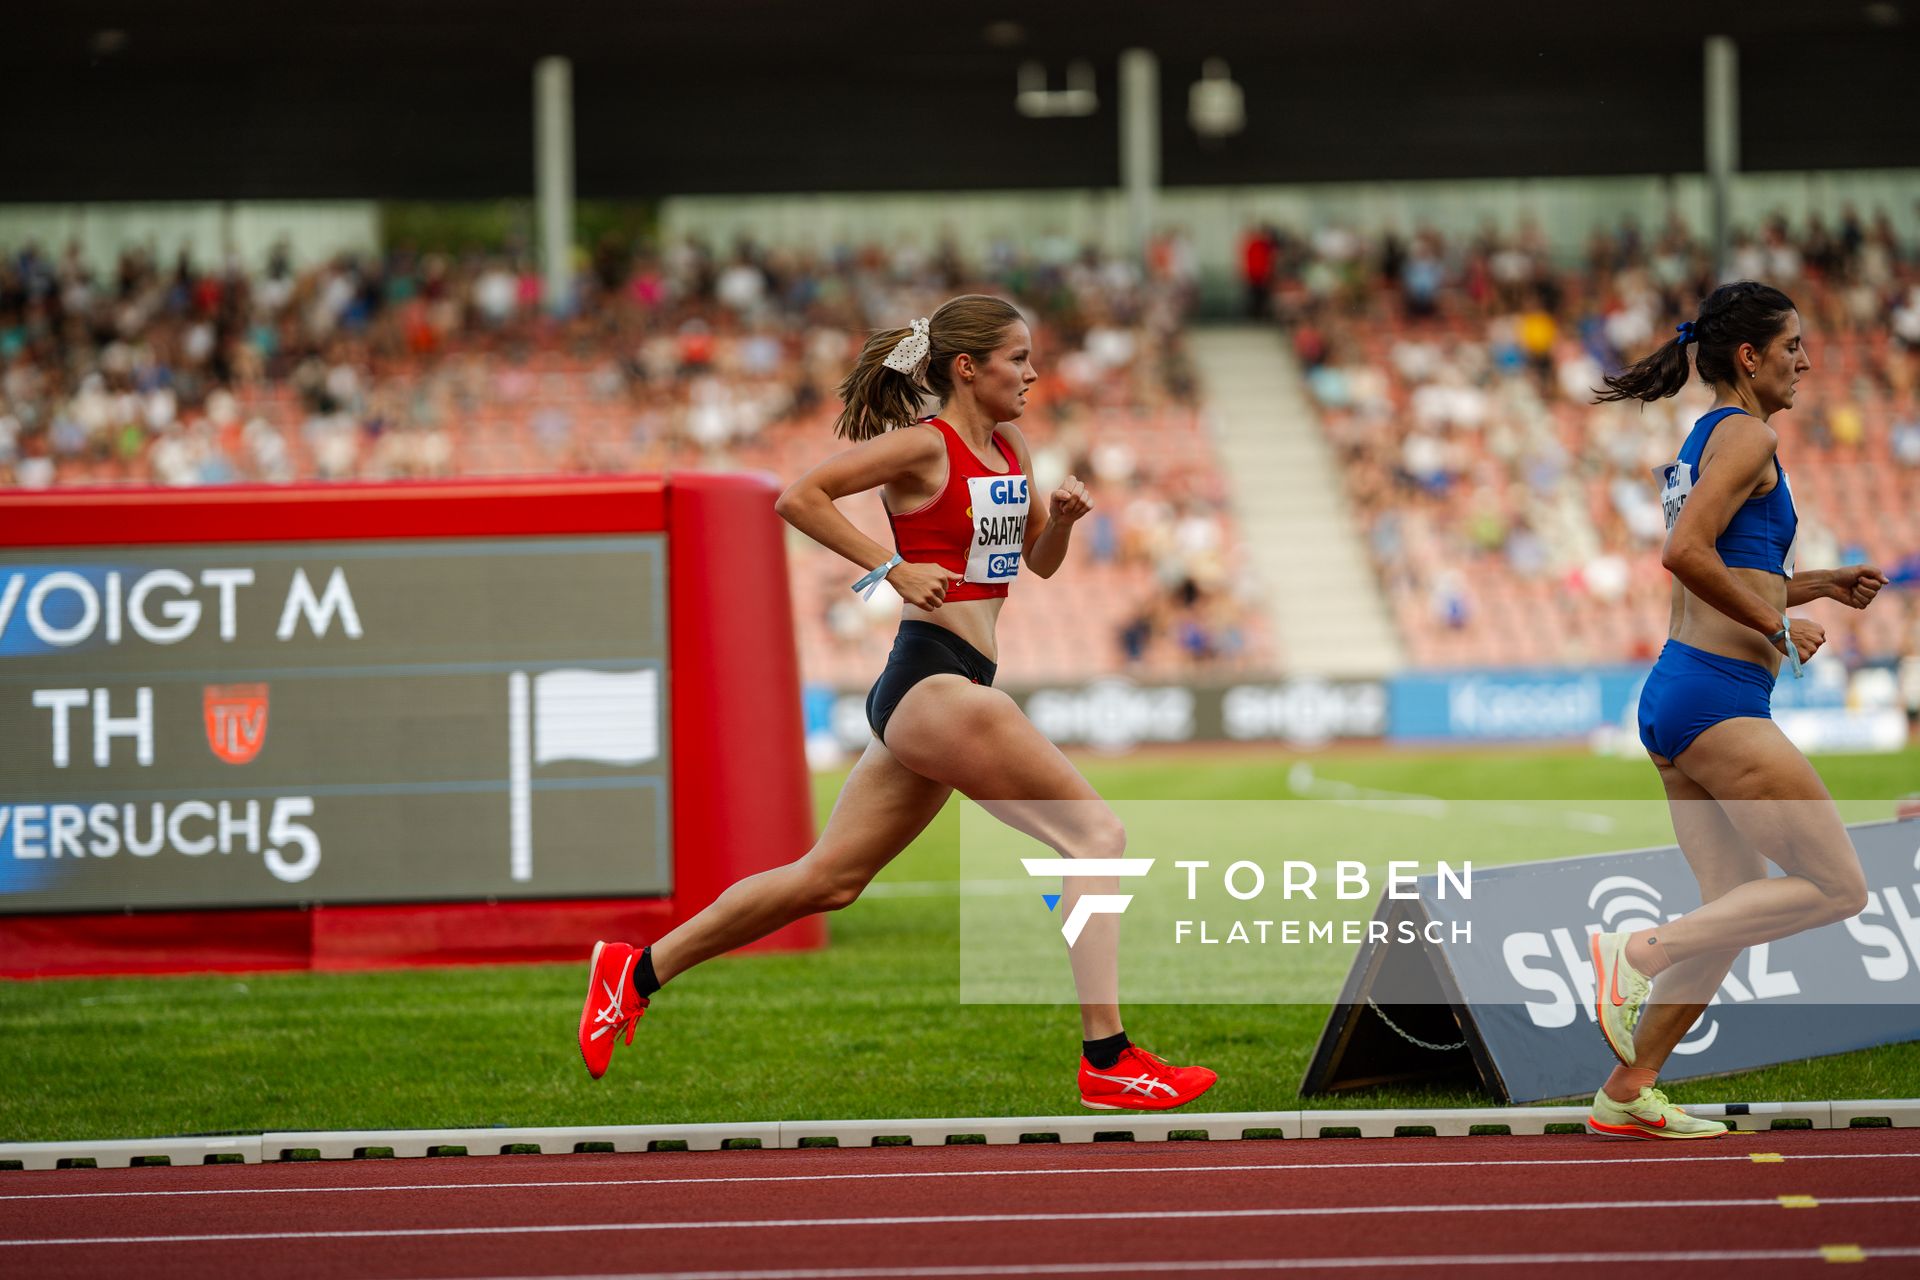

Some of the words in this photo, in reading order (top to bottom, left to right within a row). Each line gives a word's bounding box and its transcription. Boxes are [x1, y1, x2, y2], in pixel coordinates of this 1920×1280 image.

[990, 479, 1027, 505] GLS
[276, 566, 364, 641] M
[32, 687, 154, 768] TH
[264, 796, 321, 883] 5
